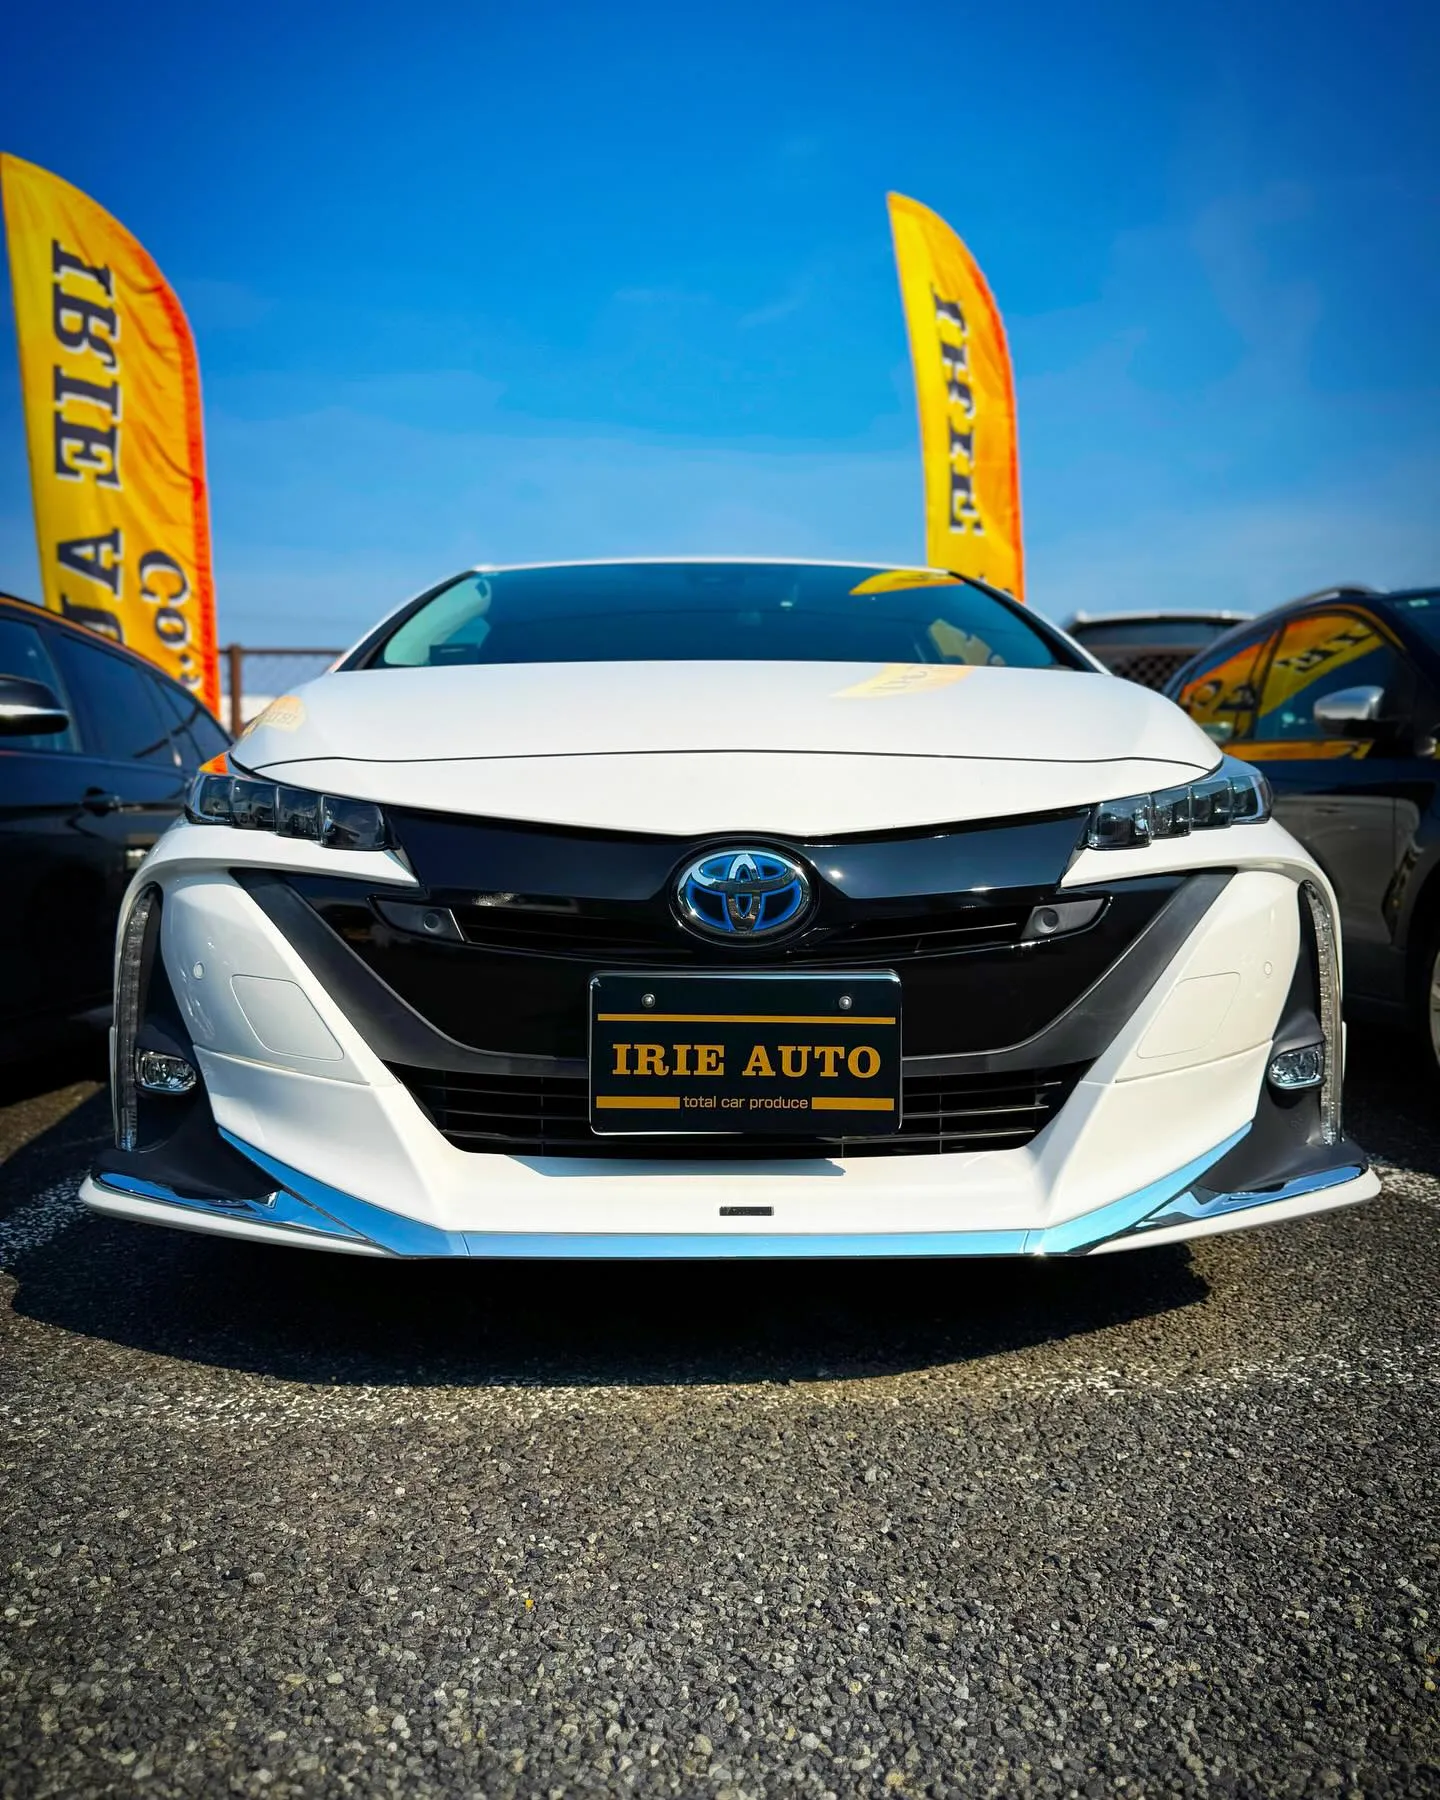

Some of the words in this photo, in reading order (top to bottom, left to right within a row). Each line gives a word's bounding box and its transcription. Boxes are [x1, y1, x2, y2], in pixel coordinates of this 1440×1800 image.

[612, 1043, 725, 1076] IRIE
[742, 1045, 881, 1078] AUTO
[683, 1096, 717, 1108] total
[721, 1098, 745, 1108] car
[749, 1096, 808, 1110] produce
